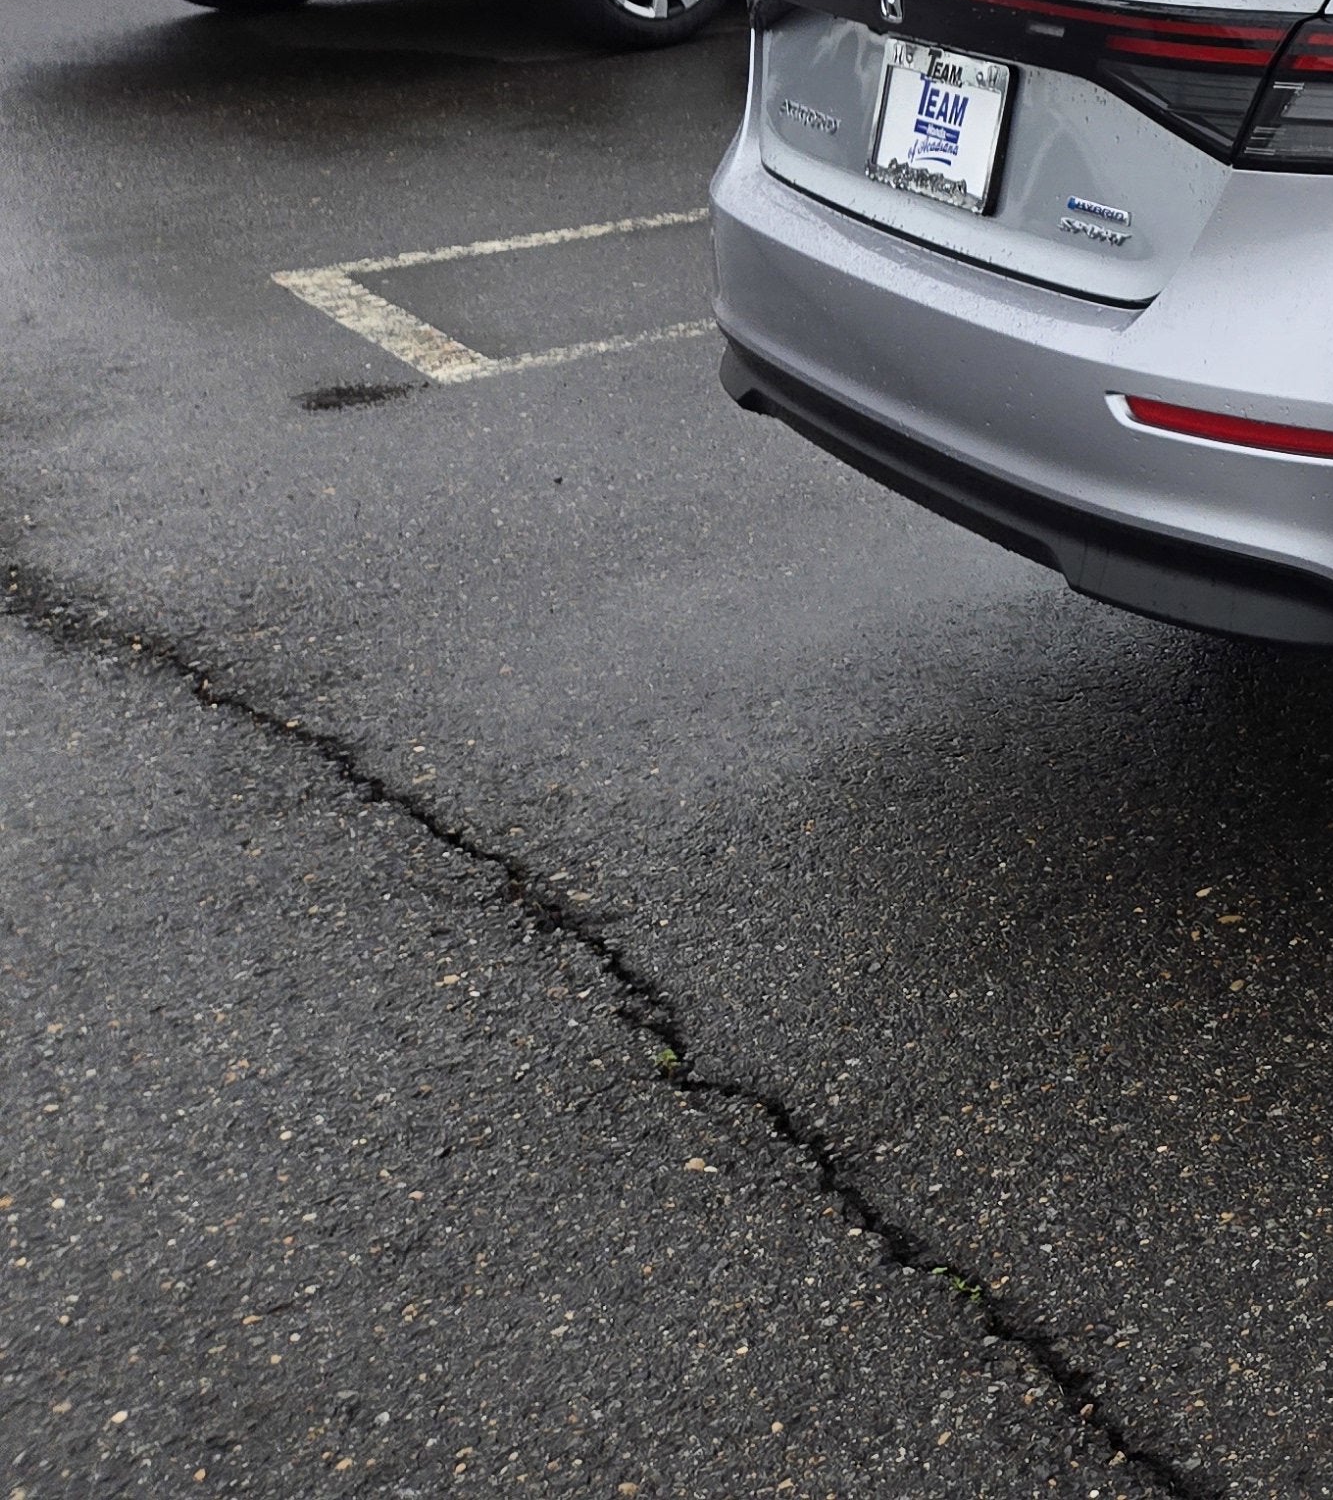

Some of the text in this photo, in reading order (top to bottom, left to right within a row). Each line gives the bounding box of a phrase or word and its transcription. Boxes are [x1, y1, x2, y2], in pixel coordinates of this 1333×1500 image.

[928, 49, 963, 88] TEAM
[917, 73, 969, 127] TEAM
[1075, 201, 1125, 221] HYBRID
